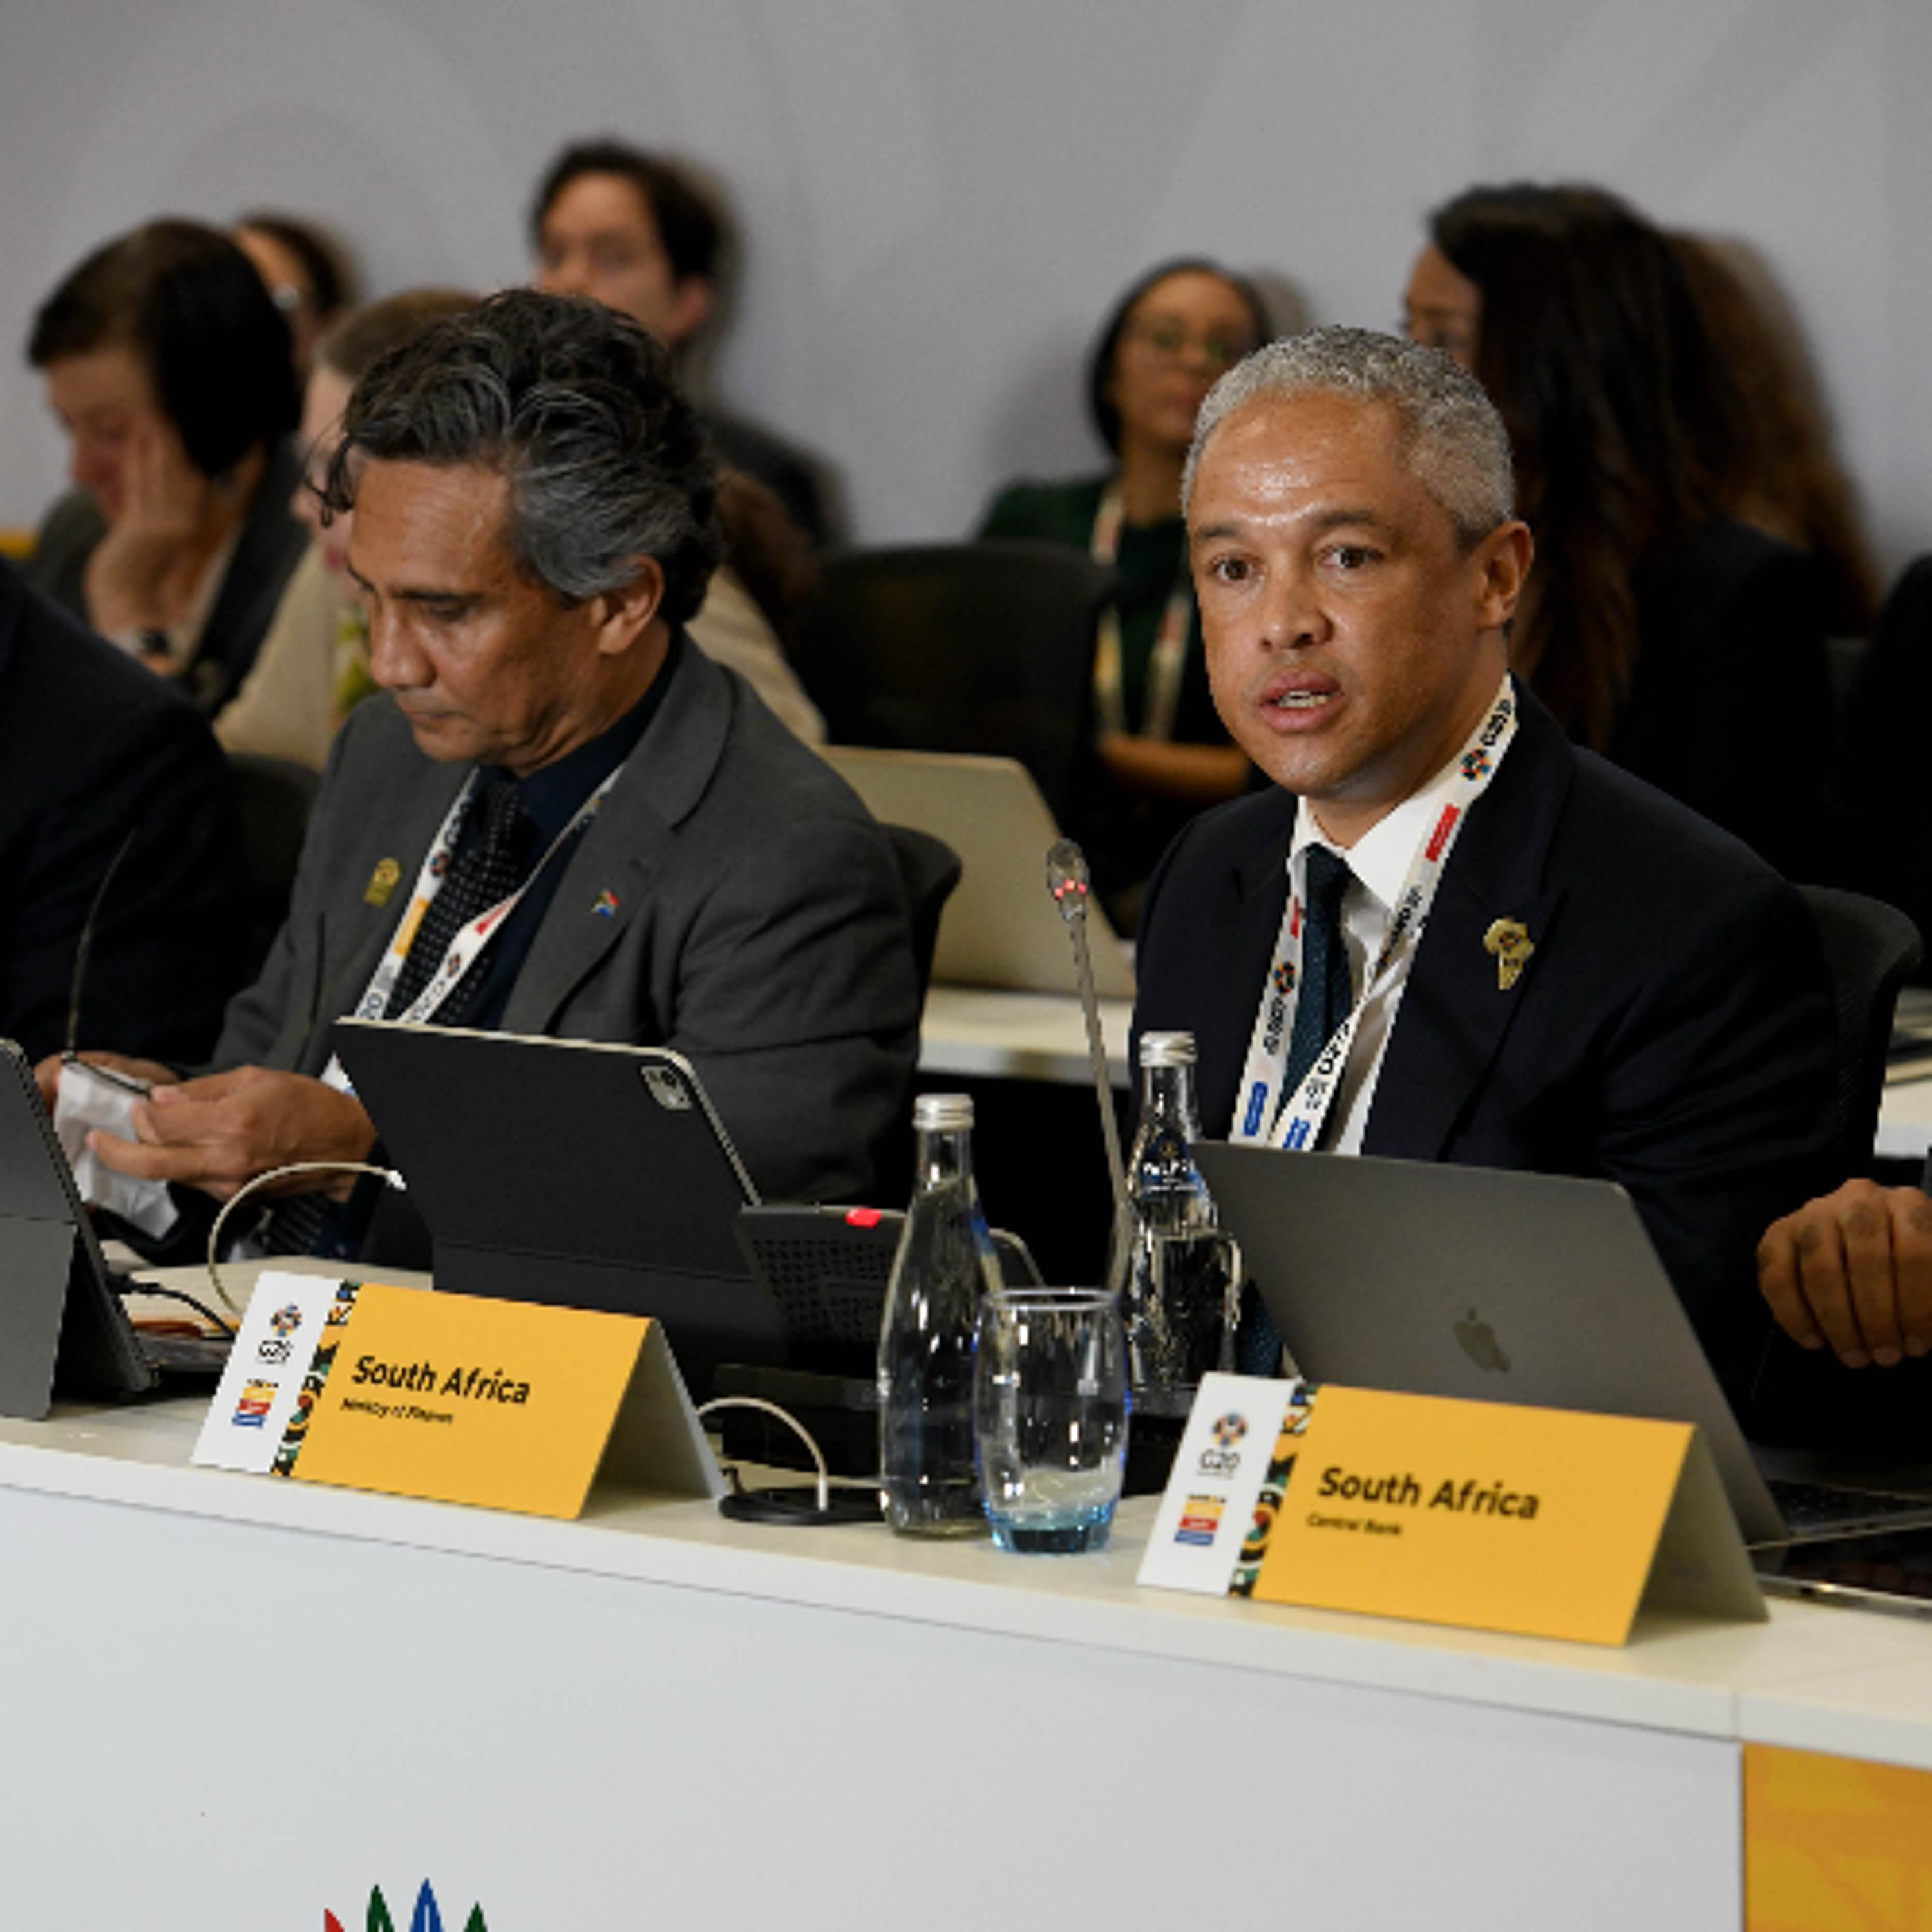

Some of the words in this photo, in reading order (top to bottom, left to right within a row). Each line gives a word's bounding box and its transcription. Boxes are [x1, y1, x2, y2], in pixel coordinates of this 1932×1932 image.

[351, 1355, 437, 1392] South
[440, 1367, 531, 1404] Africa
[1199, 1448, 1240, 1470] G20
[1318, 1466, 1421, 1506] South
[1430, 1479, 1539, 1519] Africa
[1307, 1511, 1359, 1531] Central
[1363, 1519, 1401, 1535] Bank
